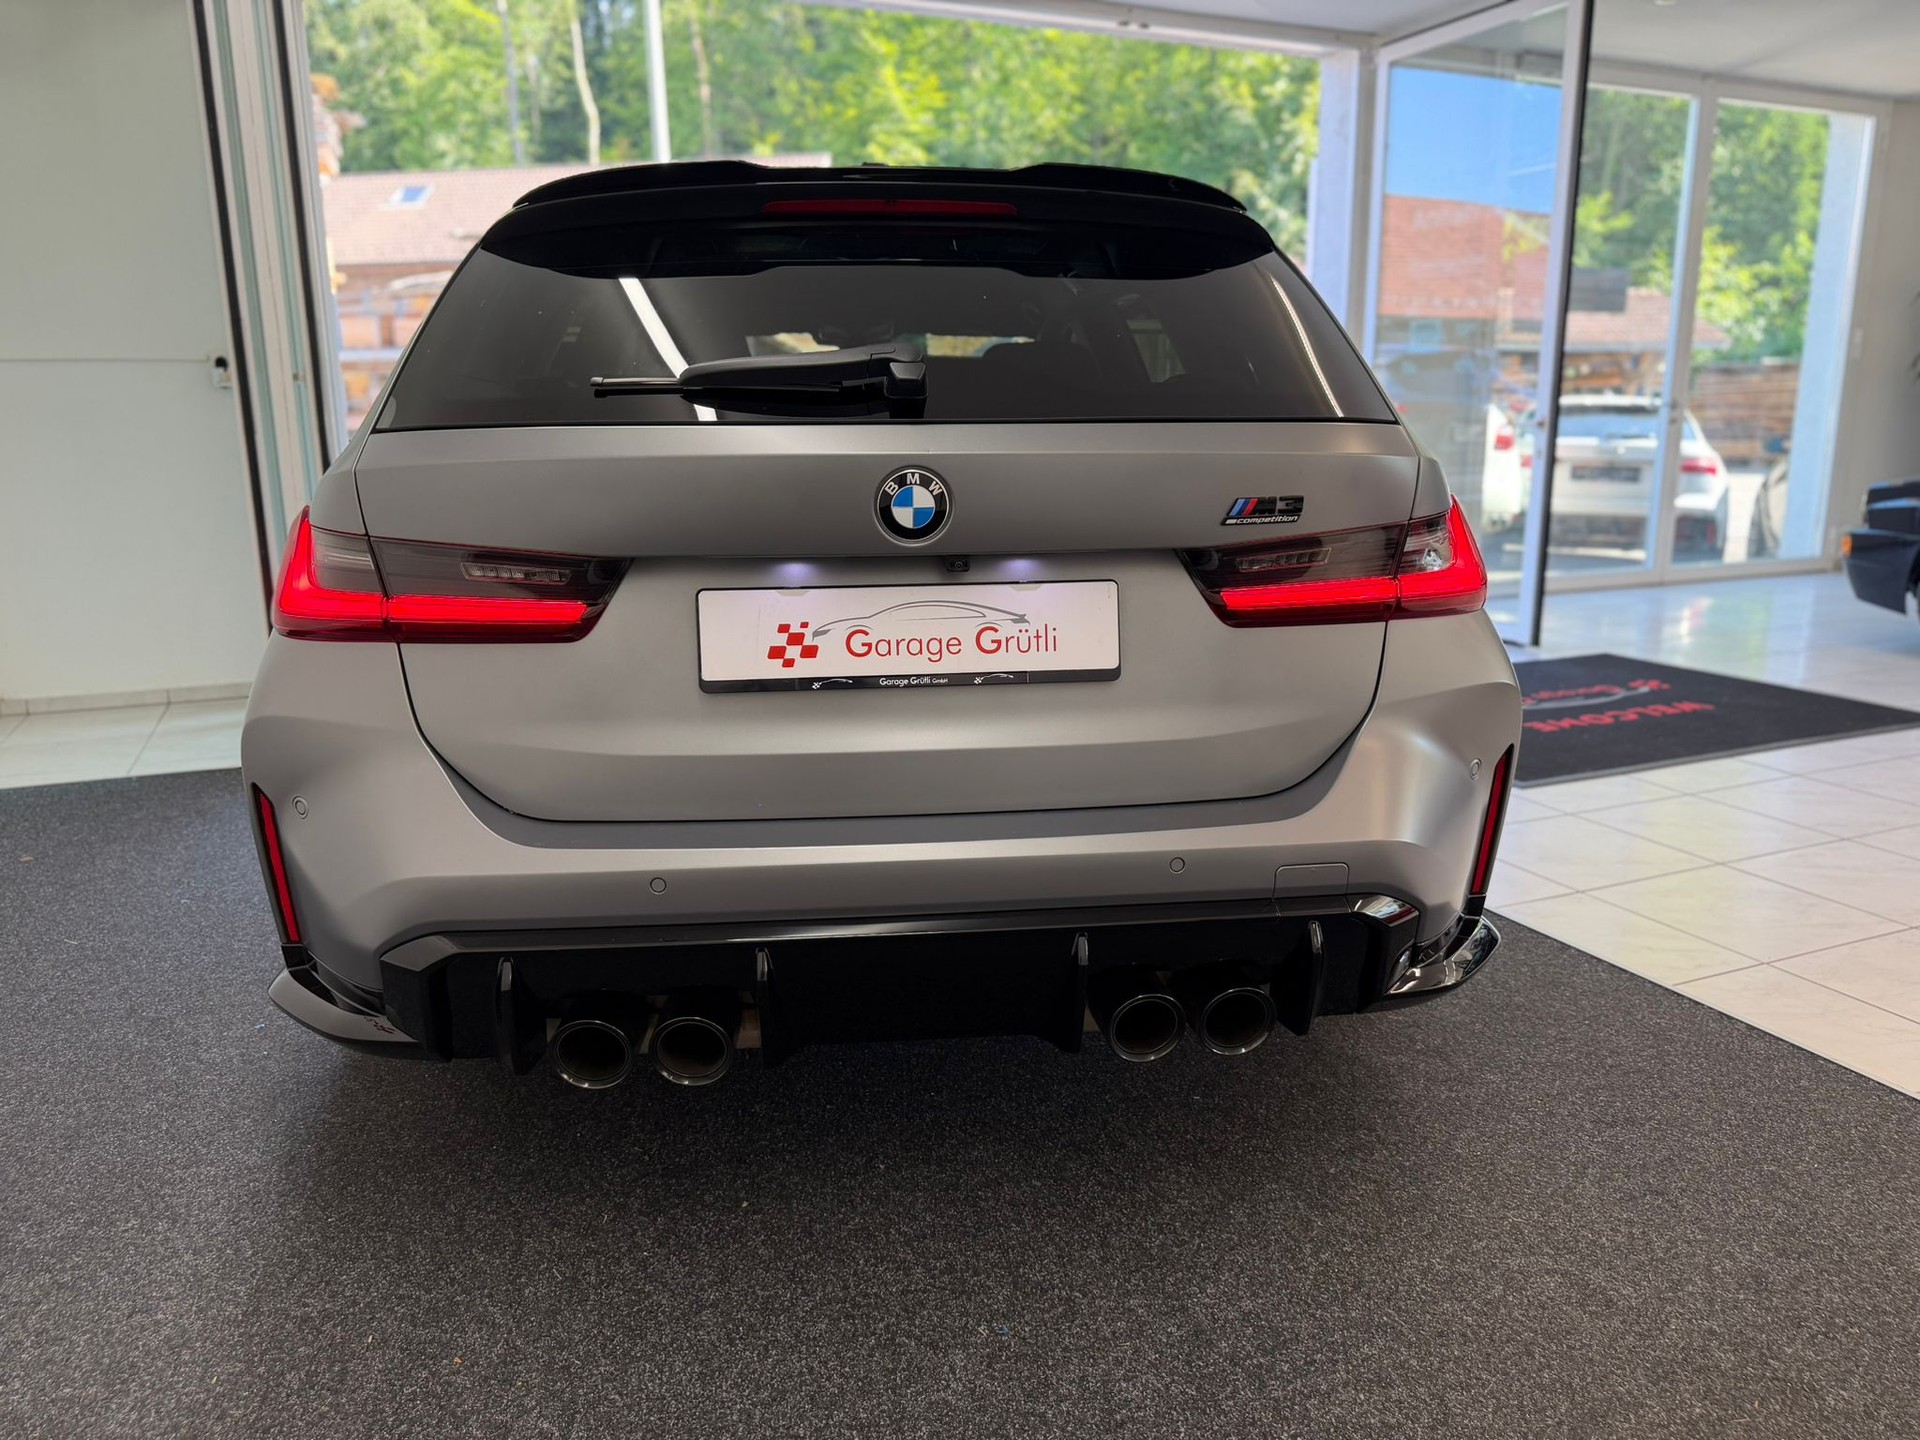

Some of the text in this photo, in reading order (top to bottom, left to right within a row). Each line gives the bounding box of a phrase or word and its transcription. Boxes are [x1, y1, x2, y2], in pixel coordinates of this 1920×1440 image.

[884, 473, 943, 496] BMW
[1246, 495, 1304, 515] M3
[1237, 515, 1299, 524] competition
[845, 623, 1058, 663] Garage Grütli
[879, 677, 909, 687] Garage
[910, 676, 931, 685] Grütli
[1523, 702, 1715, 732] WELCOME
